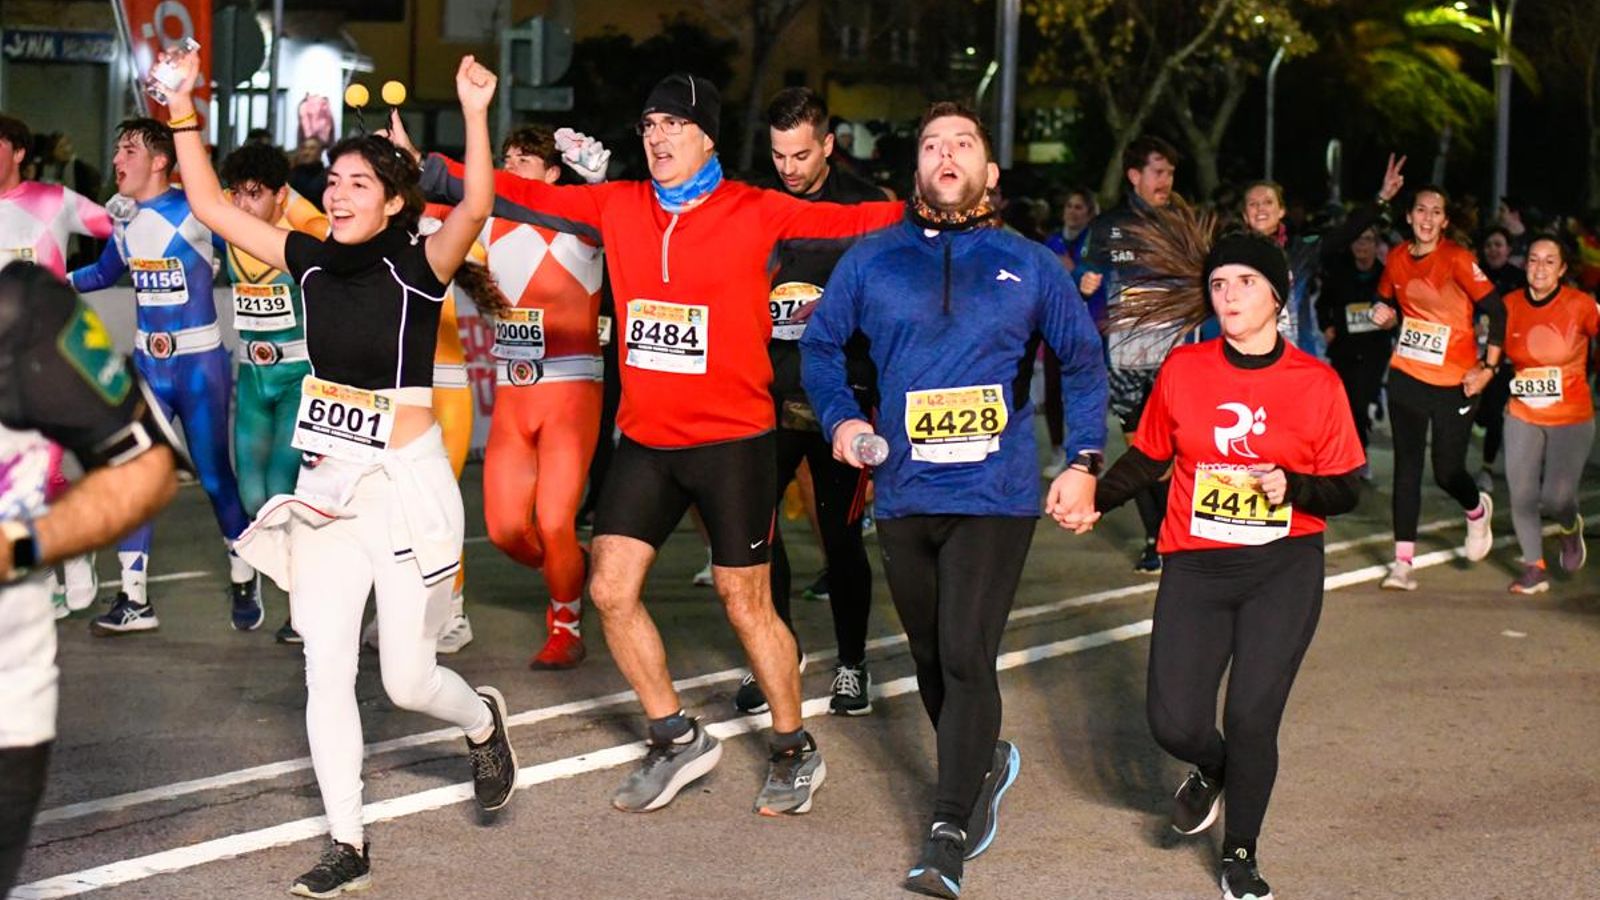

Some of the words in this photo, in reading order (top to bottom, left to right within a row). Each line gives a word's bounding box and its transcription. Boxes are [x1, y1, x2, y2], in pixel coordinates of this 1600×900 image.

[132, 271, 183, 288] 11156
[236, 297, 286, 312] 12139
[769, 300, 803, 319] 97
[631, 319, 699, 348] 8484
[1404, 329, 1443, 349] 5976
[1515, 379, 1558, 394] 5838
[308, 399, 381, 437] 6001
[915, 408, 999, 436] 4428
